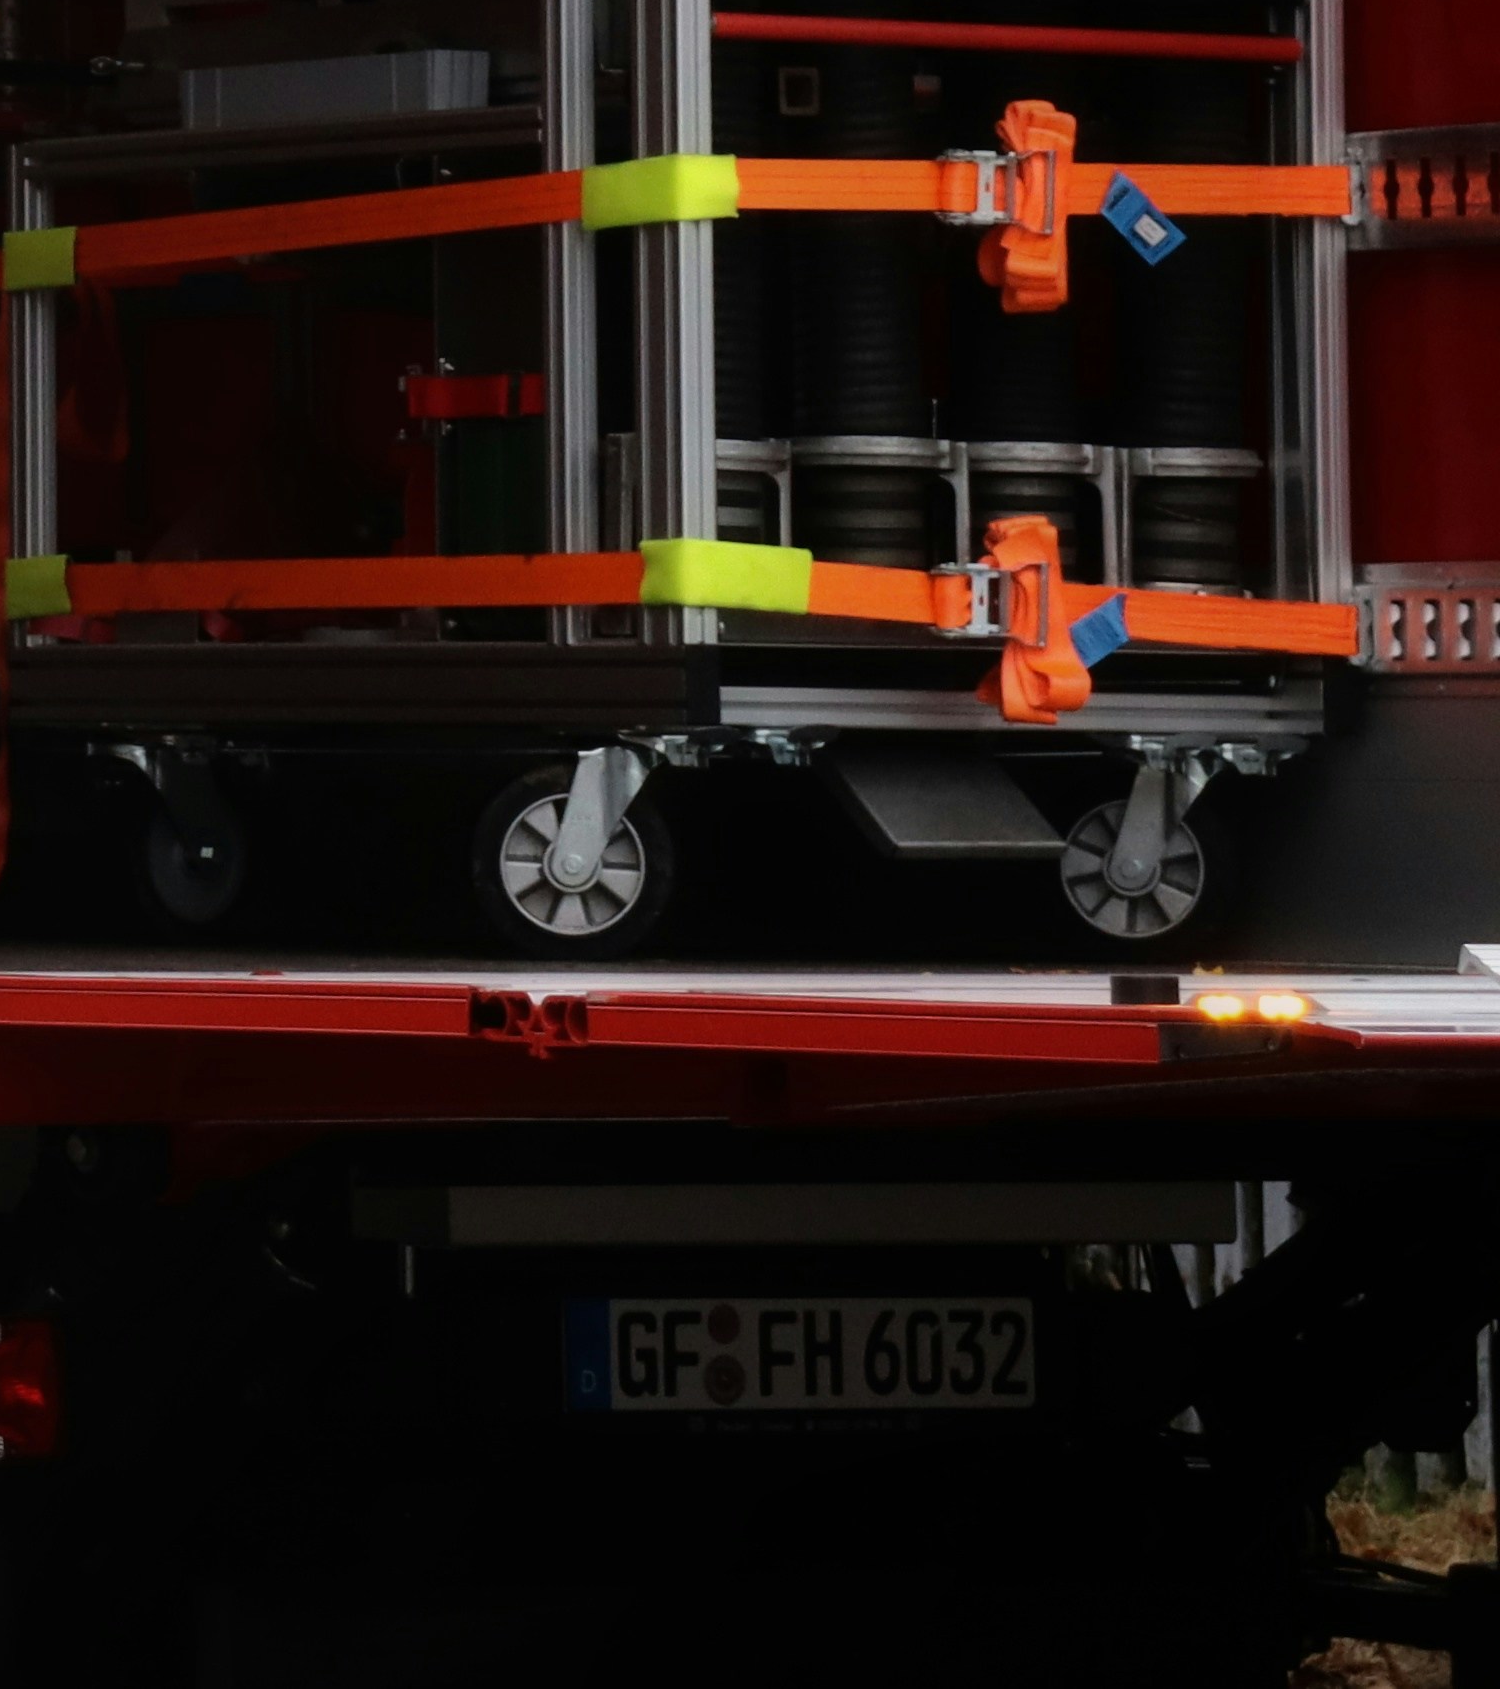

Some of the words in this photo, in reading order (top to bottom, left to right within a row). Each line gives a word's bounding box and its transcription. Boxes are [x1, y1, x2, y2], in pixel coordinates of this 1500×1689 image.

[580, 1369, 597, 1394] D
[617, 1310, 702, 1398] GF
[758, 1310, 843, 1397] FH
[864, 1310, 1028, 1397] 6032
